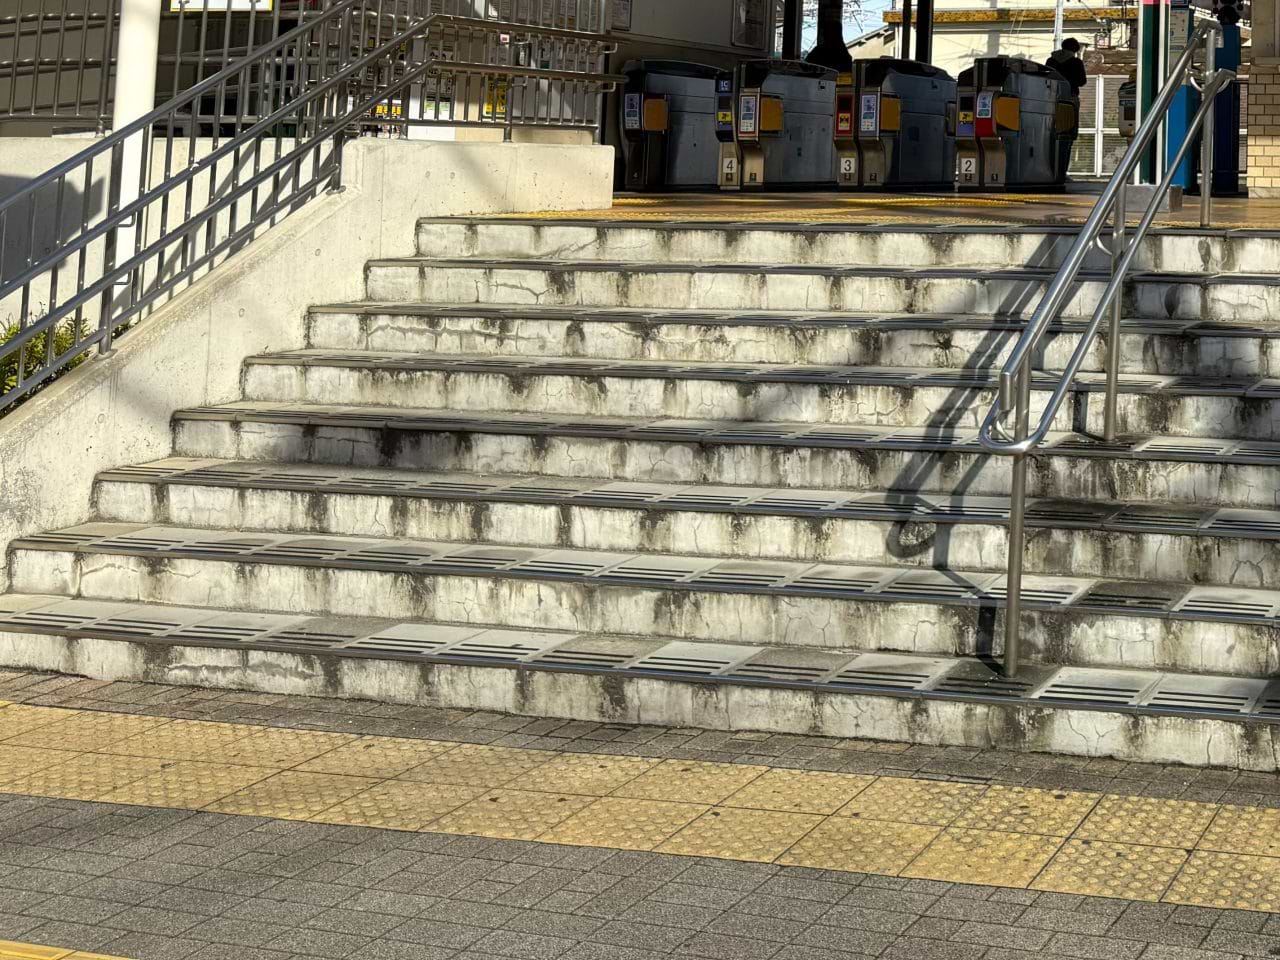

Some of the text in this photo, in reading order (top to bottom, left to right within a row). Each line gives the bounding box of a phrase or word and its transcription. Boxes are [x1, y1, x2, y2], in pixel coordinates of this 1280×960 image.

[726, 159, 734, 172] 4
[844, 159, 852, 172] 3
[964, 159, 972, 172] 2
